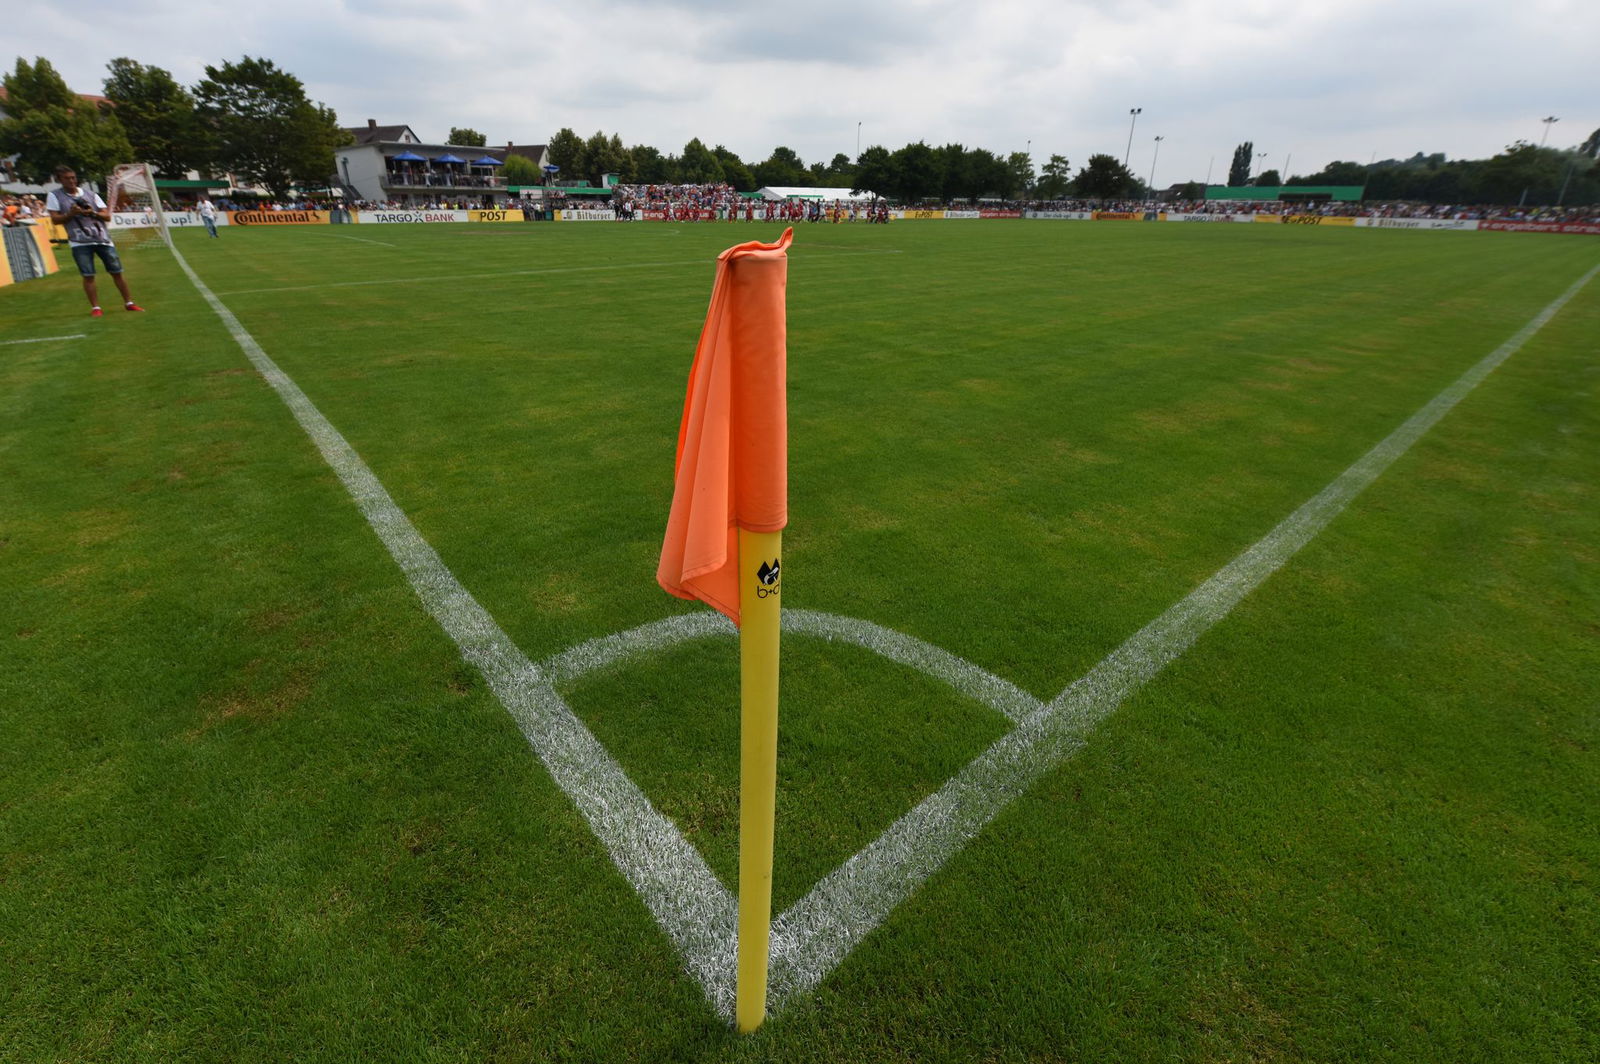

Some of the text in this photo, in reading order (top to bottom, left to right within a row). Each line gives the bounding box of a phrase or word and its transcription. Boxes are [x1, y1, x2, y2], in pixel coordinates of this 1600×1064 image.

[114, 212, 193, 226] Der clu up!
[234, 211, 310, 226] Continental
[374, 213, 454, 223] TARGO BANK
[480, 211, 507, 221] POST
